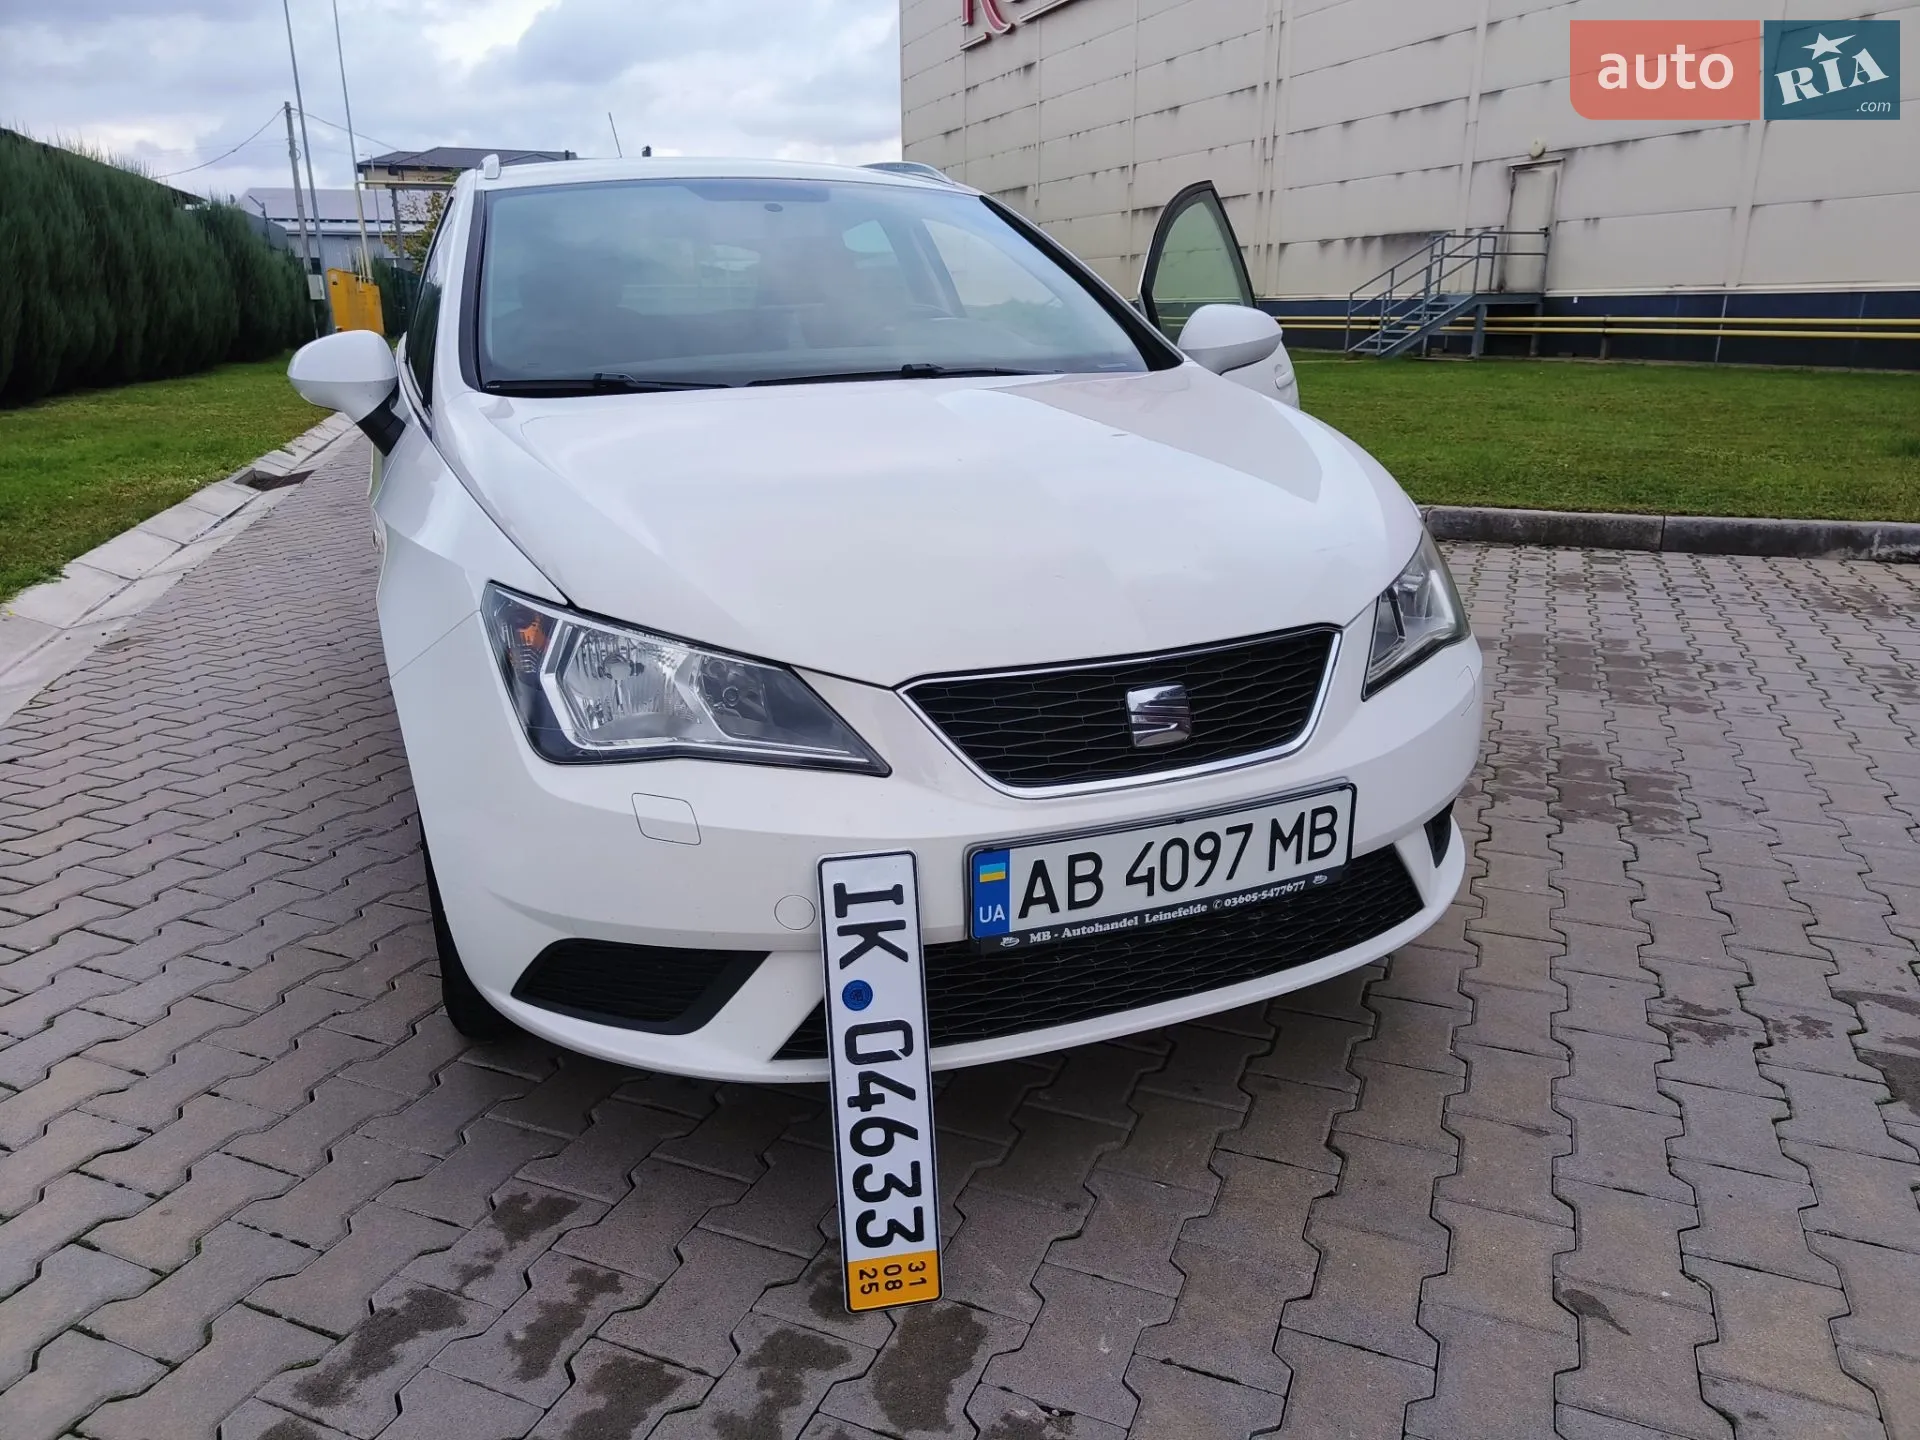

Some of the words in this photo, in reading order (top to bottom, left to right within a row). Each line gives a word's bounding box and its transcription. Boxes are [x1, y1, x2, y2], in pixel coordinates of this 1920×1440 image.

[1017, 850, 1105, 919] AB
[1125, 822, 1255, 897] 4097
[1267, 804, 1338, 872] MB
[833, 882, 909, 970] IK
[978, 904, 1006, 925] UA
[1029, 930, 1052, 944] MB
[1060, 915, 1139, 939] Autohandel
[1144, 903, 1208, 925] Leinefelde
[844, 1019, 925, 1249] 04633
[859, 1267, 880, 1295] 25
[883, 1263, 904, 1292] 08
[908, 1260, 928, 1288] 31
